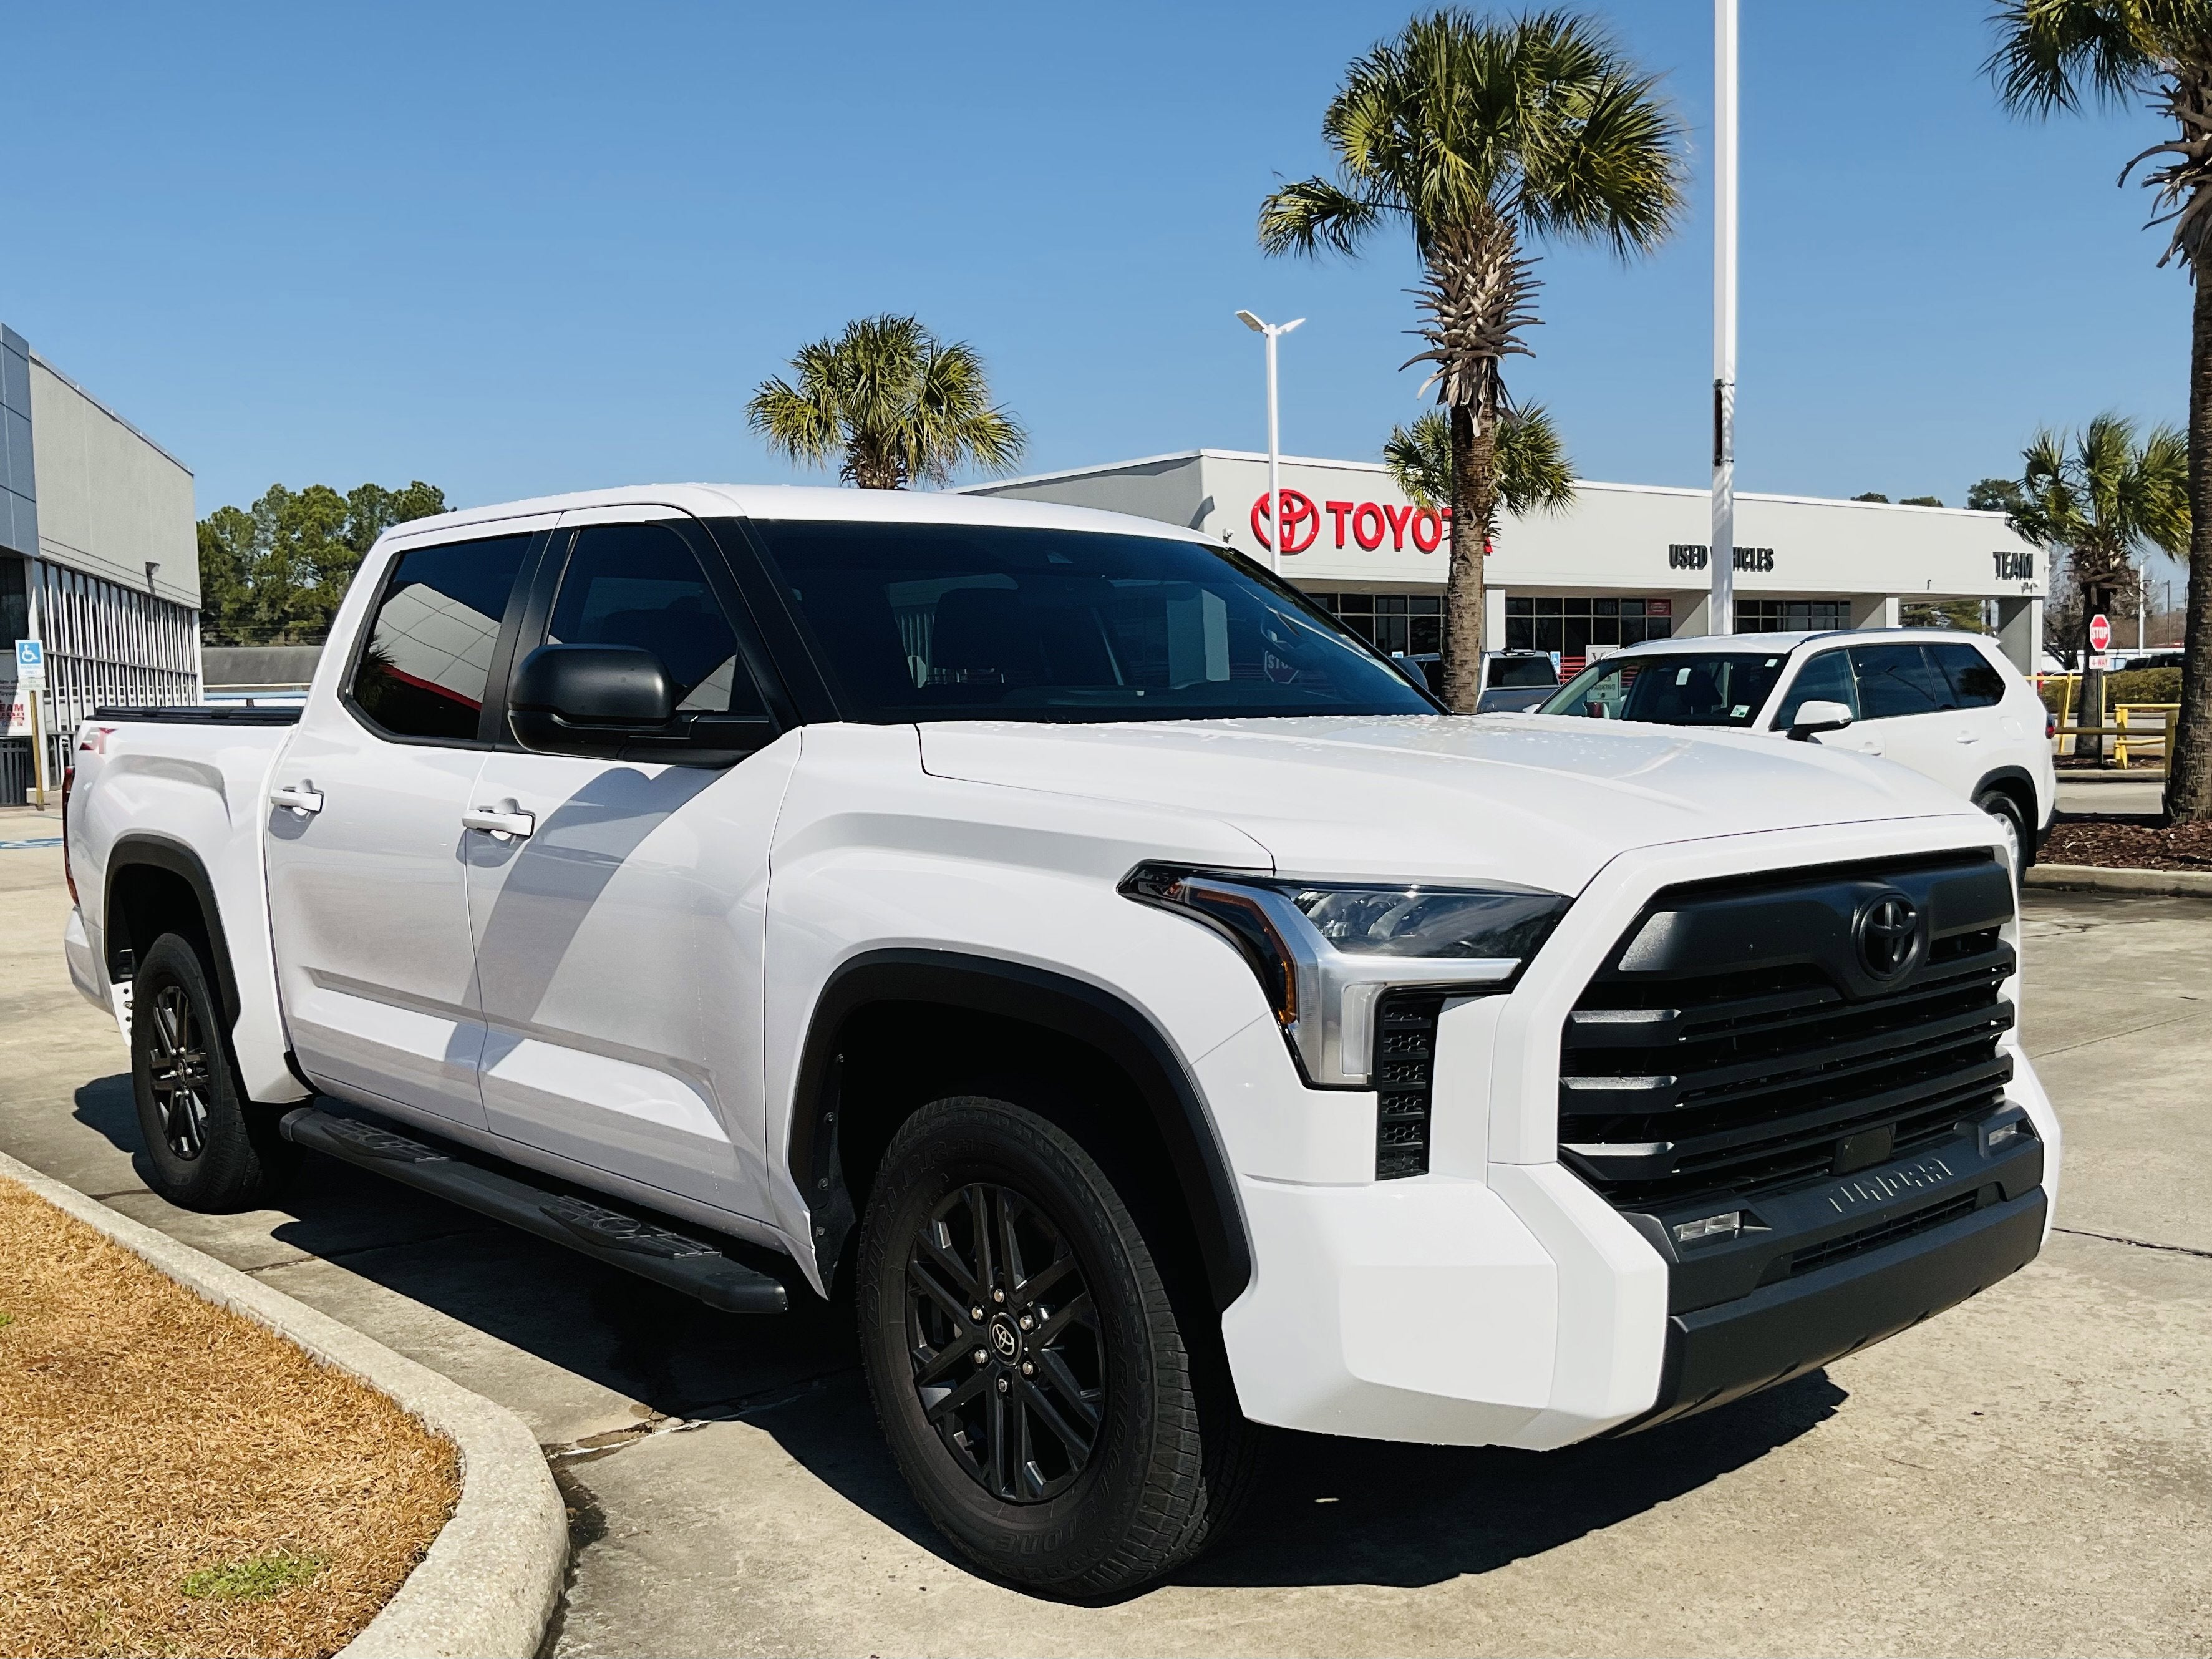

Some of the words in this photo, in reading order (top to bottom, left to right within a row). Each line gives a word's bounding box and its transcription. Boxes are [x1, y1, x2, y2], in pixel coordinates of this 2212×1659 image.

[1326, 500, 1493, 555] TOYO
[1669, 544, 1708, 569] USED
[1710, 546, 1774, 572] HICLES
[1993, 552, 2033, 580] TEAM
[2091, 626, 2108, 640] STOP
[1268, 654, 1293, 669] ST
[0, 704, 24, 712] EAM
